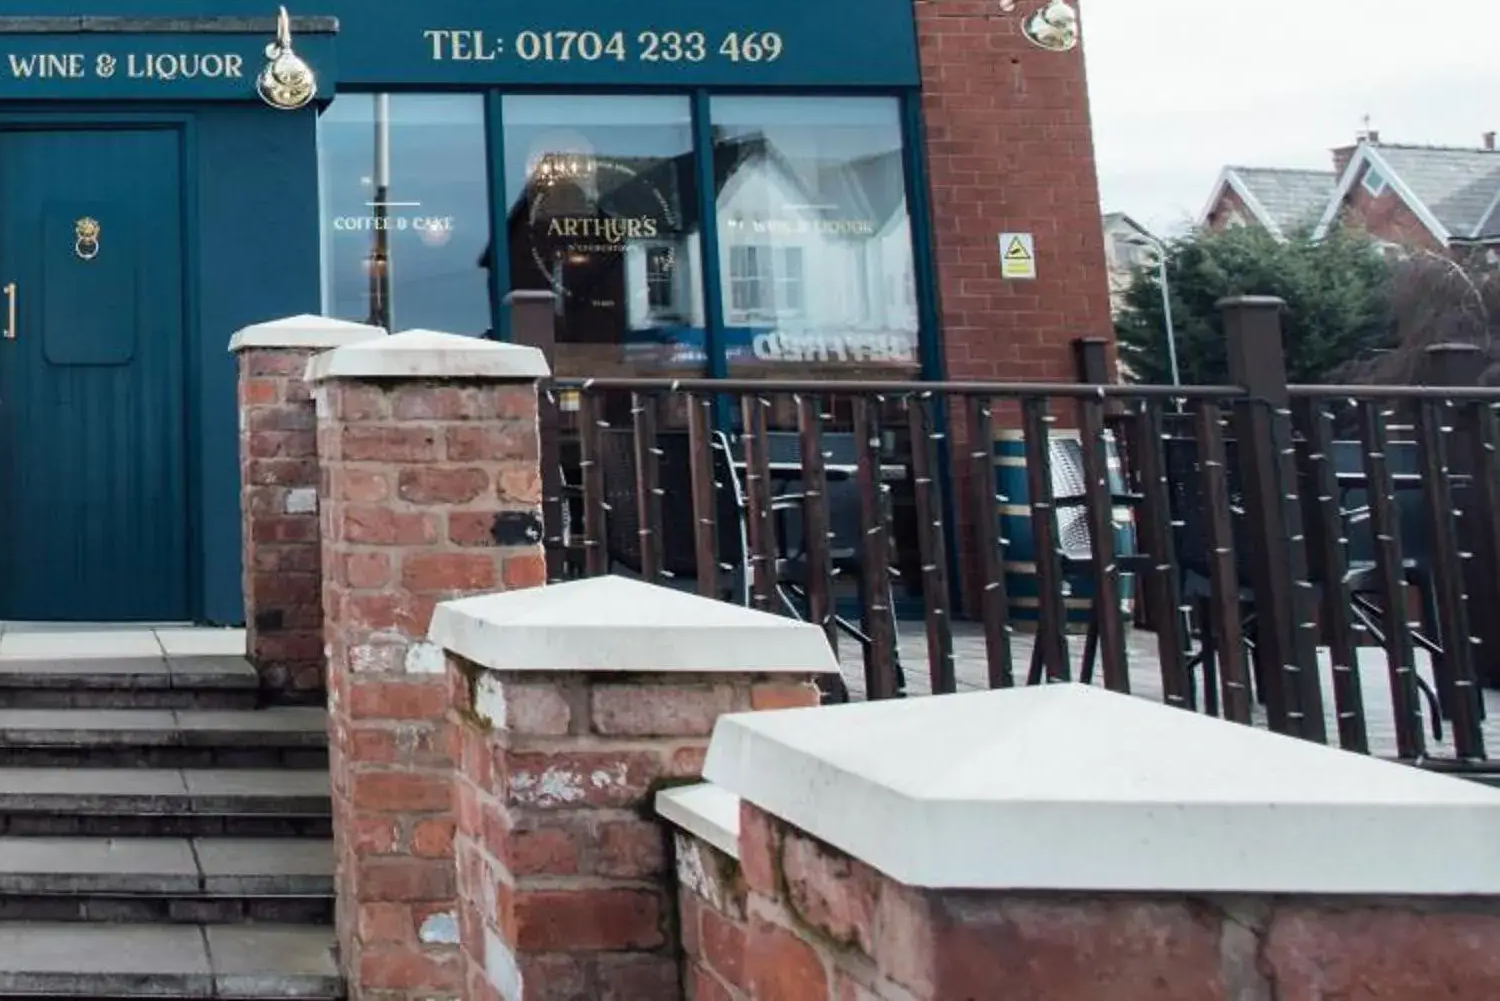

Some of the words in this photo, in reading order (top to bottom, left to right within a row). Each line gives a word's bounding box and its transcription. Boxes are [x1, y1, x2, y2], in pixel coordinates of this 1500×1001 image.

[423, 30, 504, 61] TEL:
[515, 31, 627, 61] 01704
[637, 31, 706, 62] 233
[719, 31, 783, 62] 469
[8, 54, 85, 78] WINE
[95, 54, 117, 78] &
[127, 54, 244, 80] LIQUOR
[547, 214, 658, 244] ARTHUR'S
